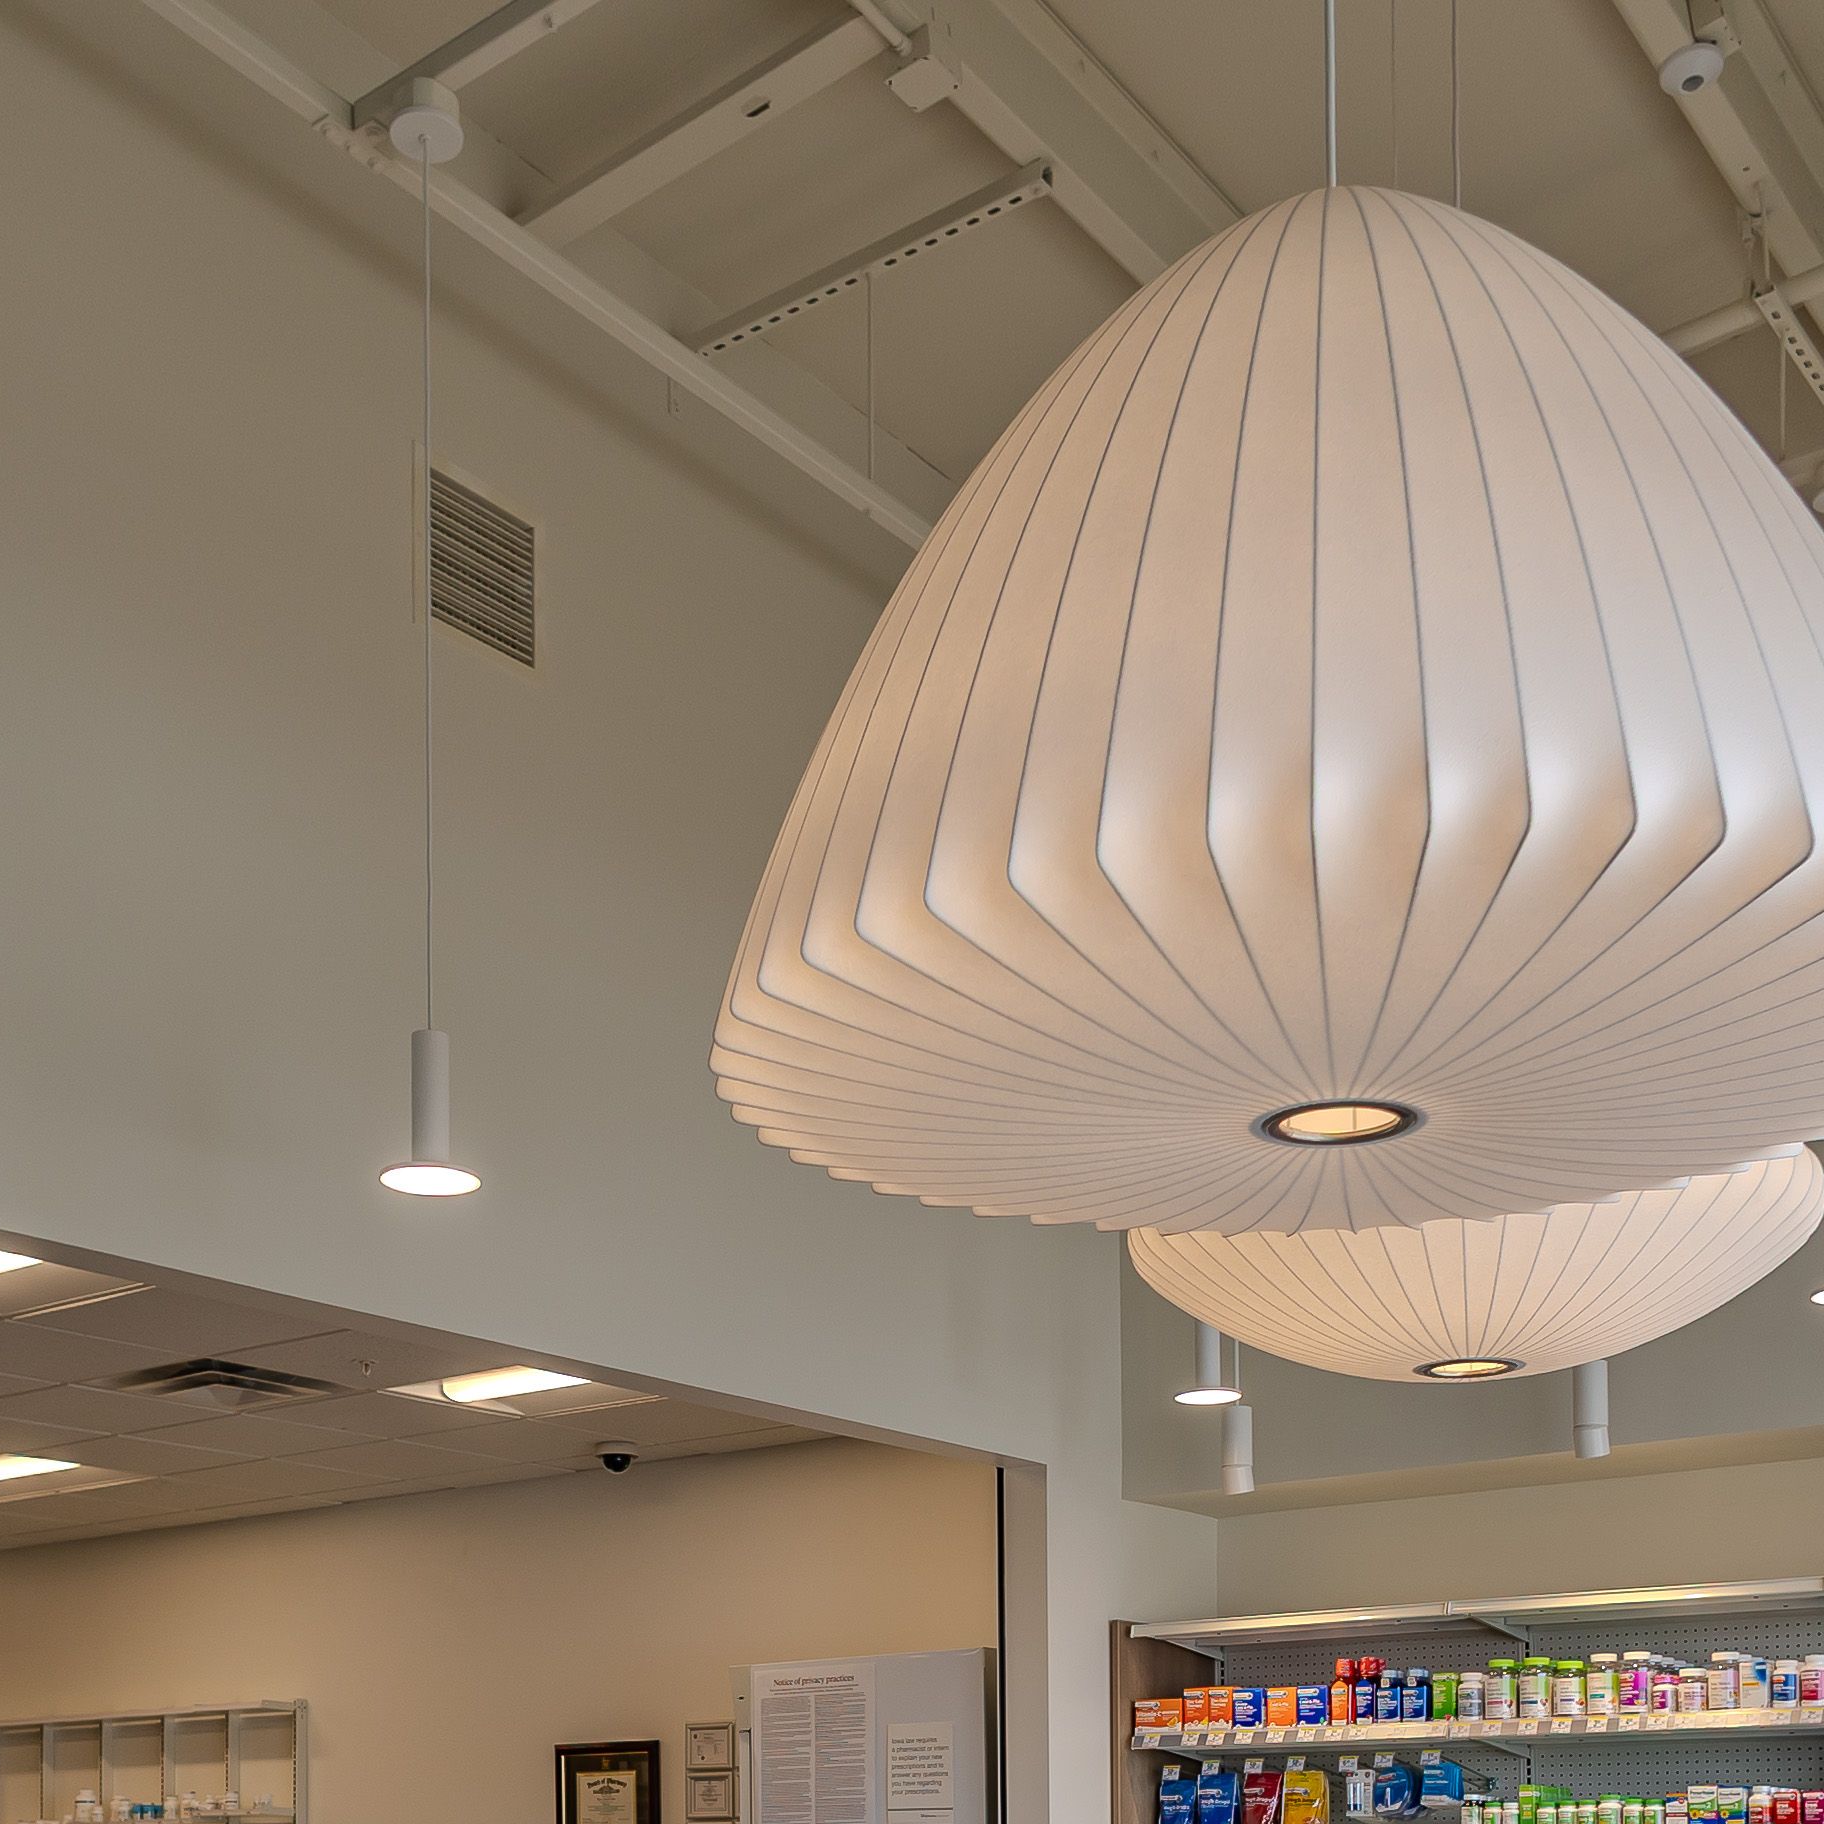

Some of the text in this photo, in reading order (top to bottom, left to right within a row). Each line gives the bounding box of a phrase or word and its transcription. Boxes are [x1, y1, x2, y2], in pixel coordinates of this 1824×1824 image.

[773, 1674, 855, 1687] Notice of privacy practices
[915, 1736, 937, 1746] requires
[896, 1746, 926, 1754] pharmacist
[891, 1762, 926, 1770] prescriptions
[922, 1770, 948, 1778] questions
[892, 1780, 902, 1788] you
[917, 1779, 942, 1787] regarding
[904, 1787, 940, 1796] prescriptions.
